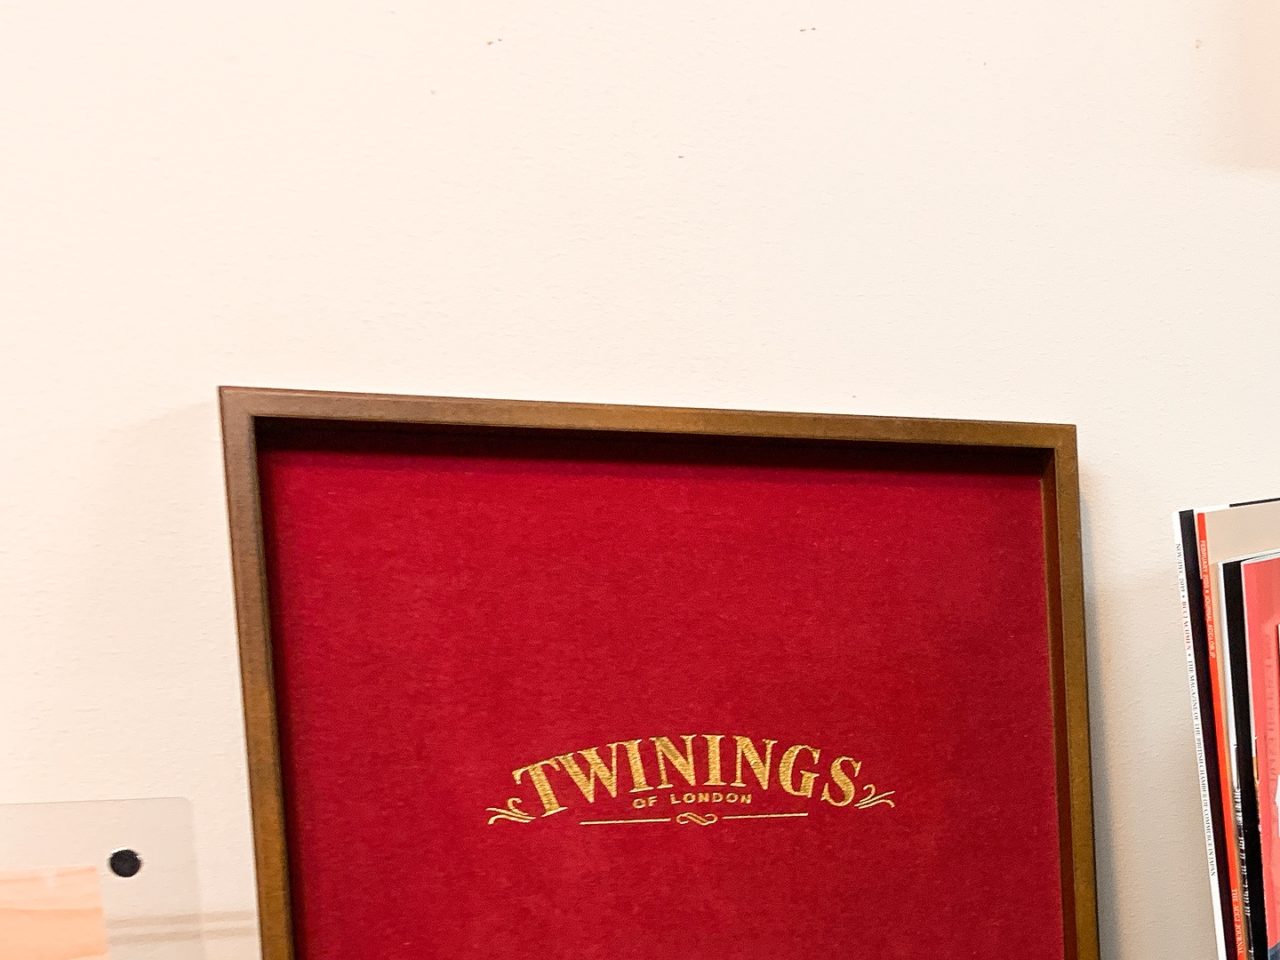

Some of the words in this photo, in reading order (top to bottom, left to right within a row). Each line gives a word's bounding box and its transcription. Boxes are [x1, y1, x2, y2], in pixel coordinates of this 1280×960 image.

[511, 733, 863, 819] TWININGS
[632, 794, 659, 809] OF
[670, 791, 753, 806] LONDON
